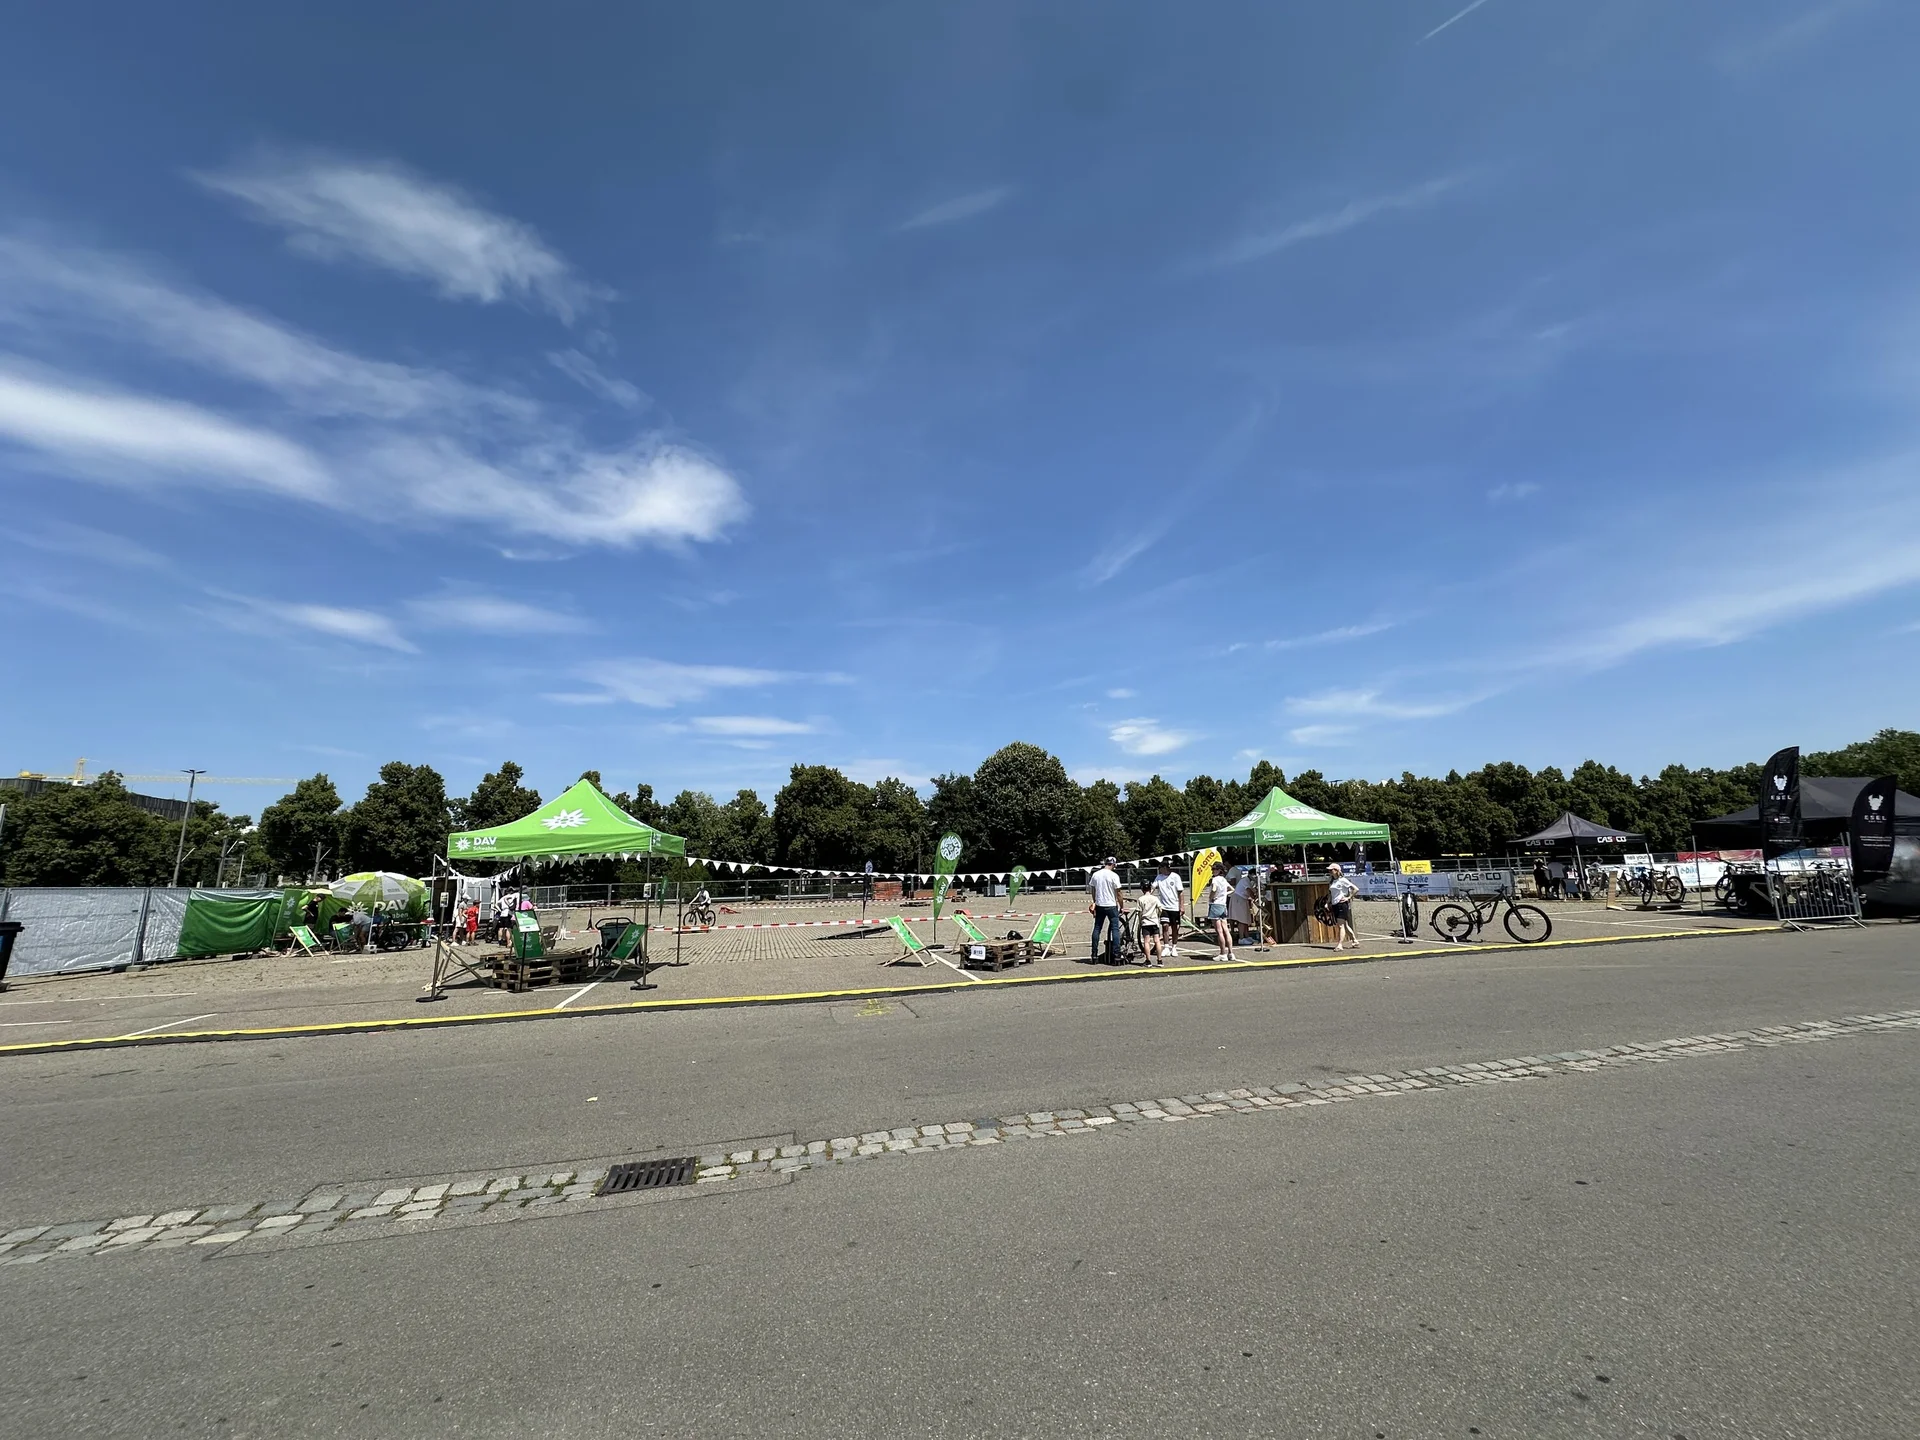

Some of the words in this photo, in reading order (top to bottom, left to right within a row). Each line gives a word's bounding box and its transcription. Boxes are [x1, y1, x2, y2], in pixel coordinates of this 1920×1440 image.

[473, 836, 497, 846] DAV
[1201, 851, 1215, 869] LOTTO
[939, 881, 947, 895] DAV
